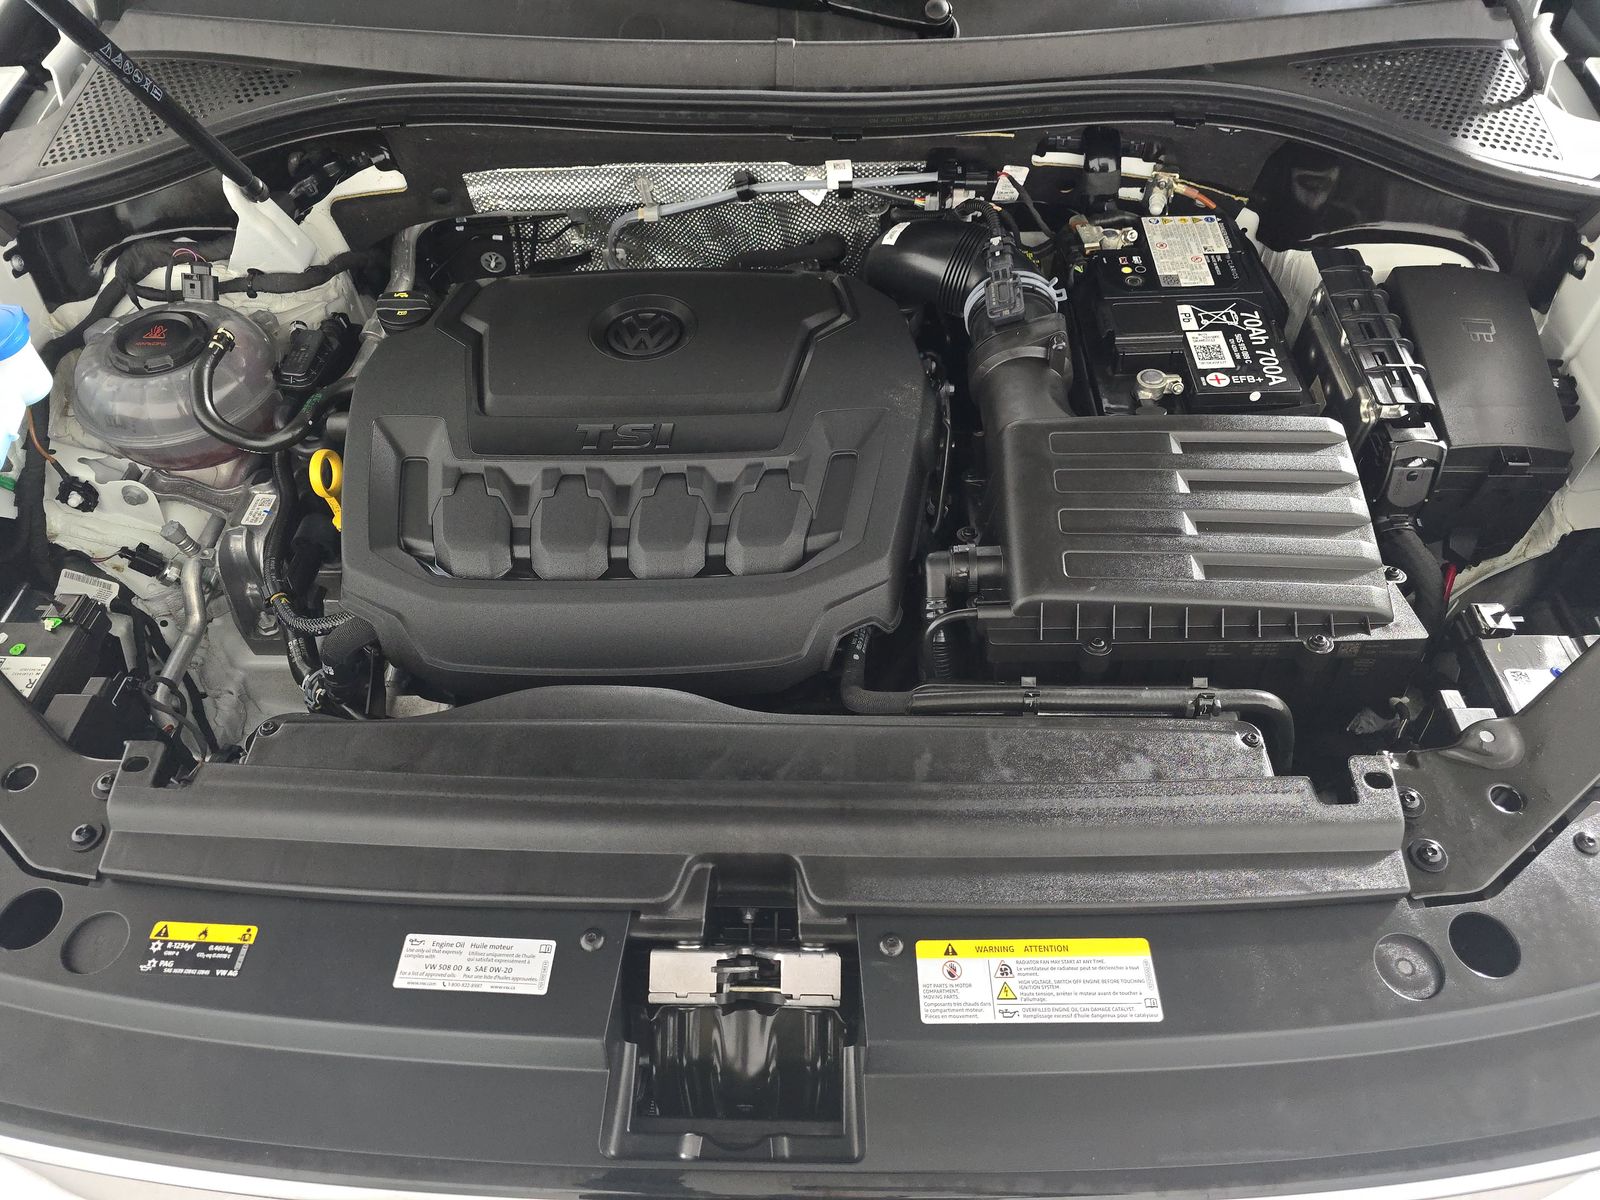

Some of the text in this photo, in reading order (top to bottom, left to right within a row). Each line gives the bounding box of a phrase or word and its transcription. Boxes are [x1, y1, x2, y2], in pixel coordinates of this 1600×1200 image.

[1180, 312, 1191, 323] Pb
[1240, 311, 1287, 387] 70Ah 700A
[1231, 375, 1264, 385] EFB+
[576, 422, 676, 450] TSI
[432, 941, 454, 949] Engine
